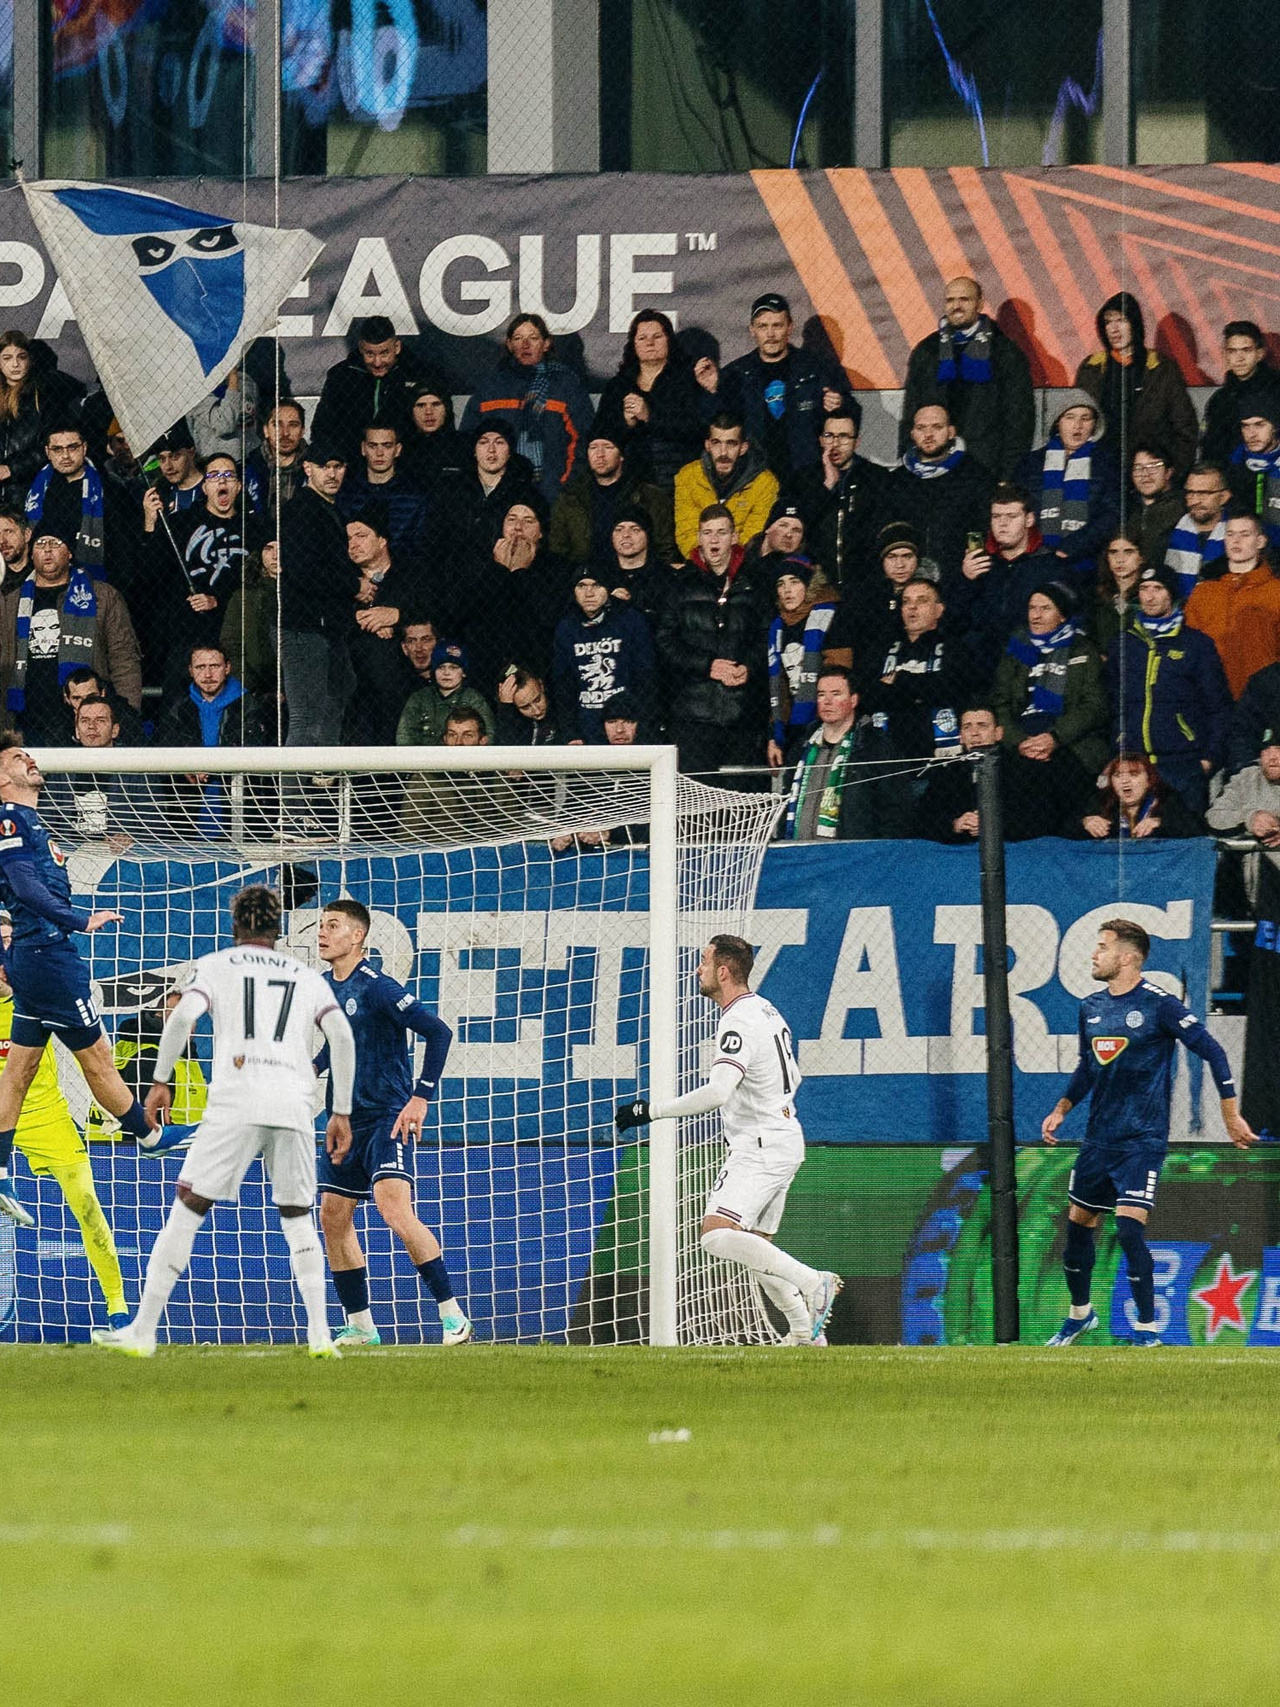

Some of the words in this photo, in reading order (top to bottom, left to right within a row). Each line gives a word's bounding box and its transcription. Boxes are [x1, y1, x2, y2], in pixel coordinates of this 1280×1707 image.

[62, 635, 93, 648] TSC
[243, 976, 296, 1042] 17
[722, 1034, 741, 1050] JD
